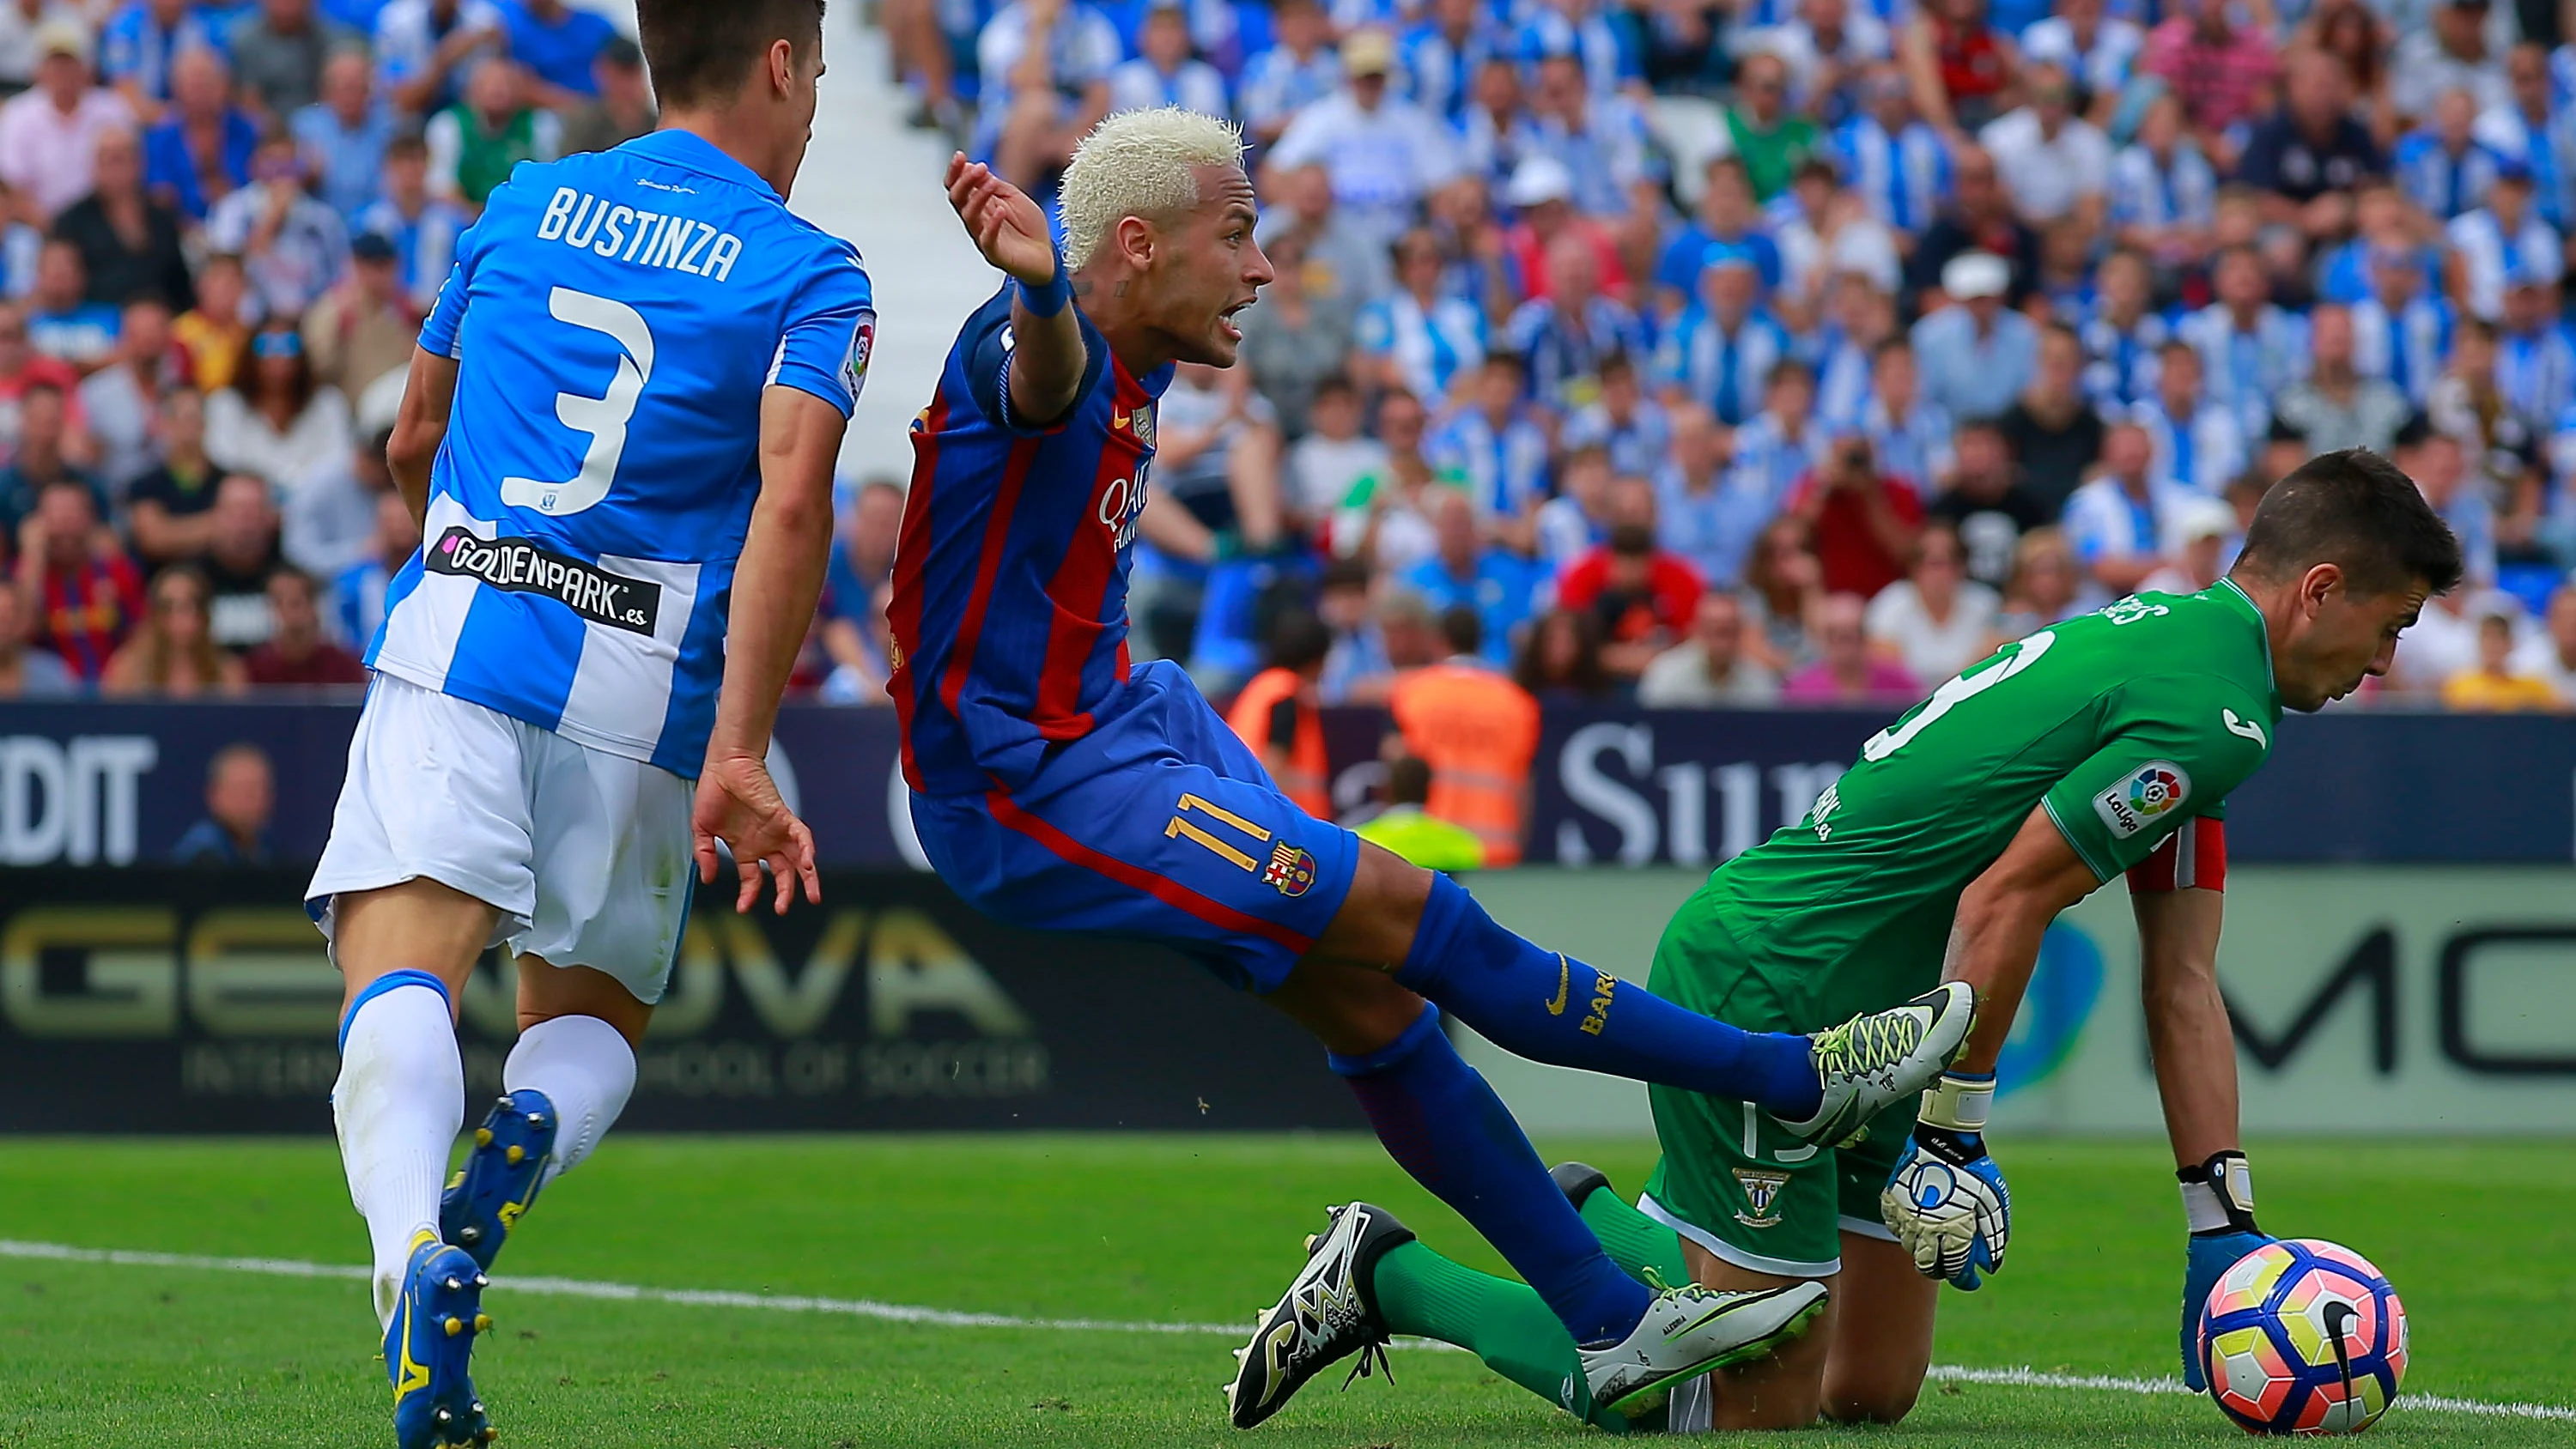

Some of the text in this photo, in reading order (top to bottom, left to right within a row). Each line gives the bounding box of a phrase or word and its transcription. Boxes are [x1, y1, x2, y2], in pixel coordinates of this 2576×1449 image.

[537, 186, 743, 282] BUSTINZA
[501, 286, 655, 516] 3
[1164, 792, 1272, 873] 11
[2105, 792, 2139, 833] LaLiga
